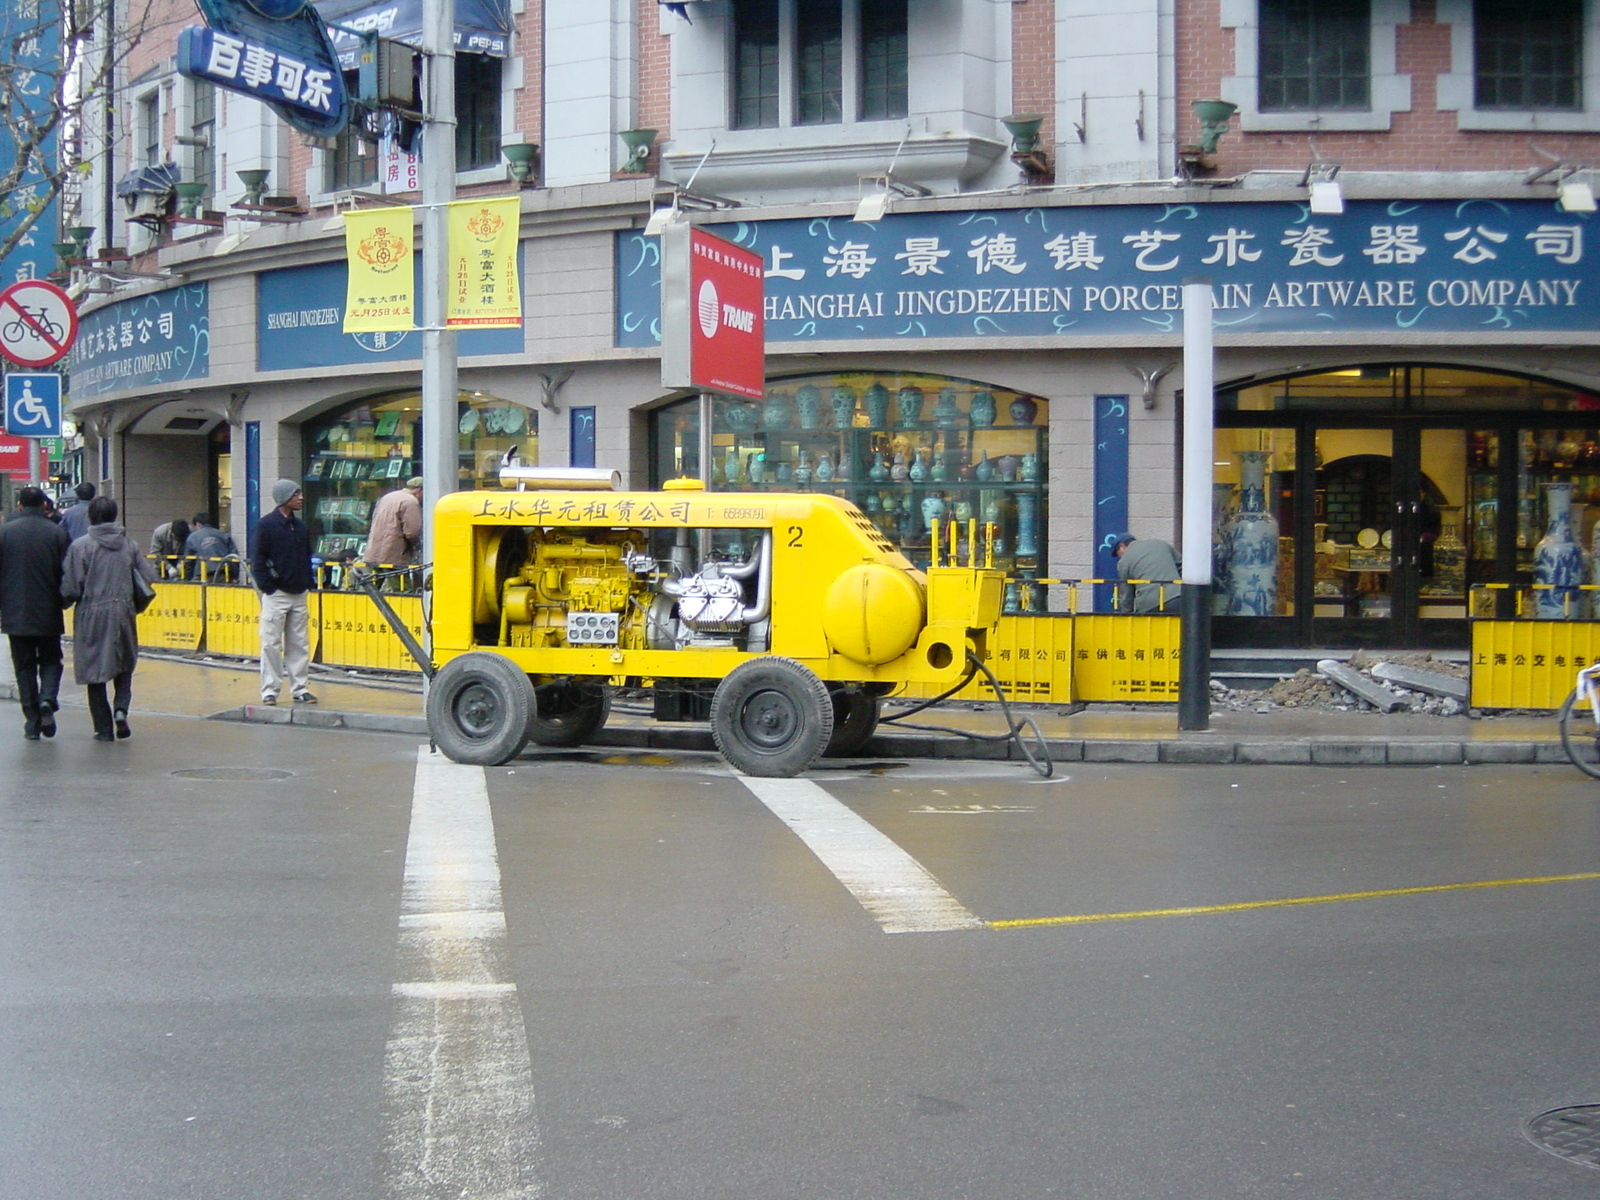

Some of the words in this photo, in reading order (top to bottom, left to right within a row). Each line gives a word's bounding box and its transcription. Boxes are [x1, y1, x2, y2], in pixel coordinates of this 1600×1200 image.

[336, 8, 398, 43] PEPSI
[469, 36, 504, 51] PEPSI
[208, 31, 333, 112] 百事可乐
[763, 224, 1582, 281] 上海景德镇艺术瓷器公司
[479, 249, 495, 305] 粤富大酒楼
[763, 292, 885, 320] HANGHAI
[894, 286, 1073, 318] JINGDEZHEN
[1084, 284, 1253, 311] PORCEAIN
[1263, 280, 1416, 308] ARTWARE
[1426, 279, 1582, 307] COMPANY
[267, 310, 299, 329] SHANGHAI
[299, 307, 340, 327] JINGDEZHEN
[349, 307, 411, 318] 元月25日试业
[723, 303, 754, 334] TRANE
[134, 350, 174, 374] COMPANY
[473, 499, 691, 524] 上水华元租赁公司
[787, 525, 803, 548] 2
[324, 619, 422, 637] 上海公交电车有
